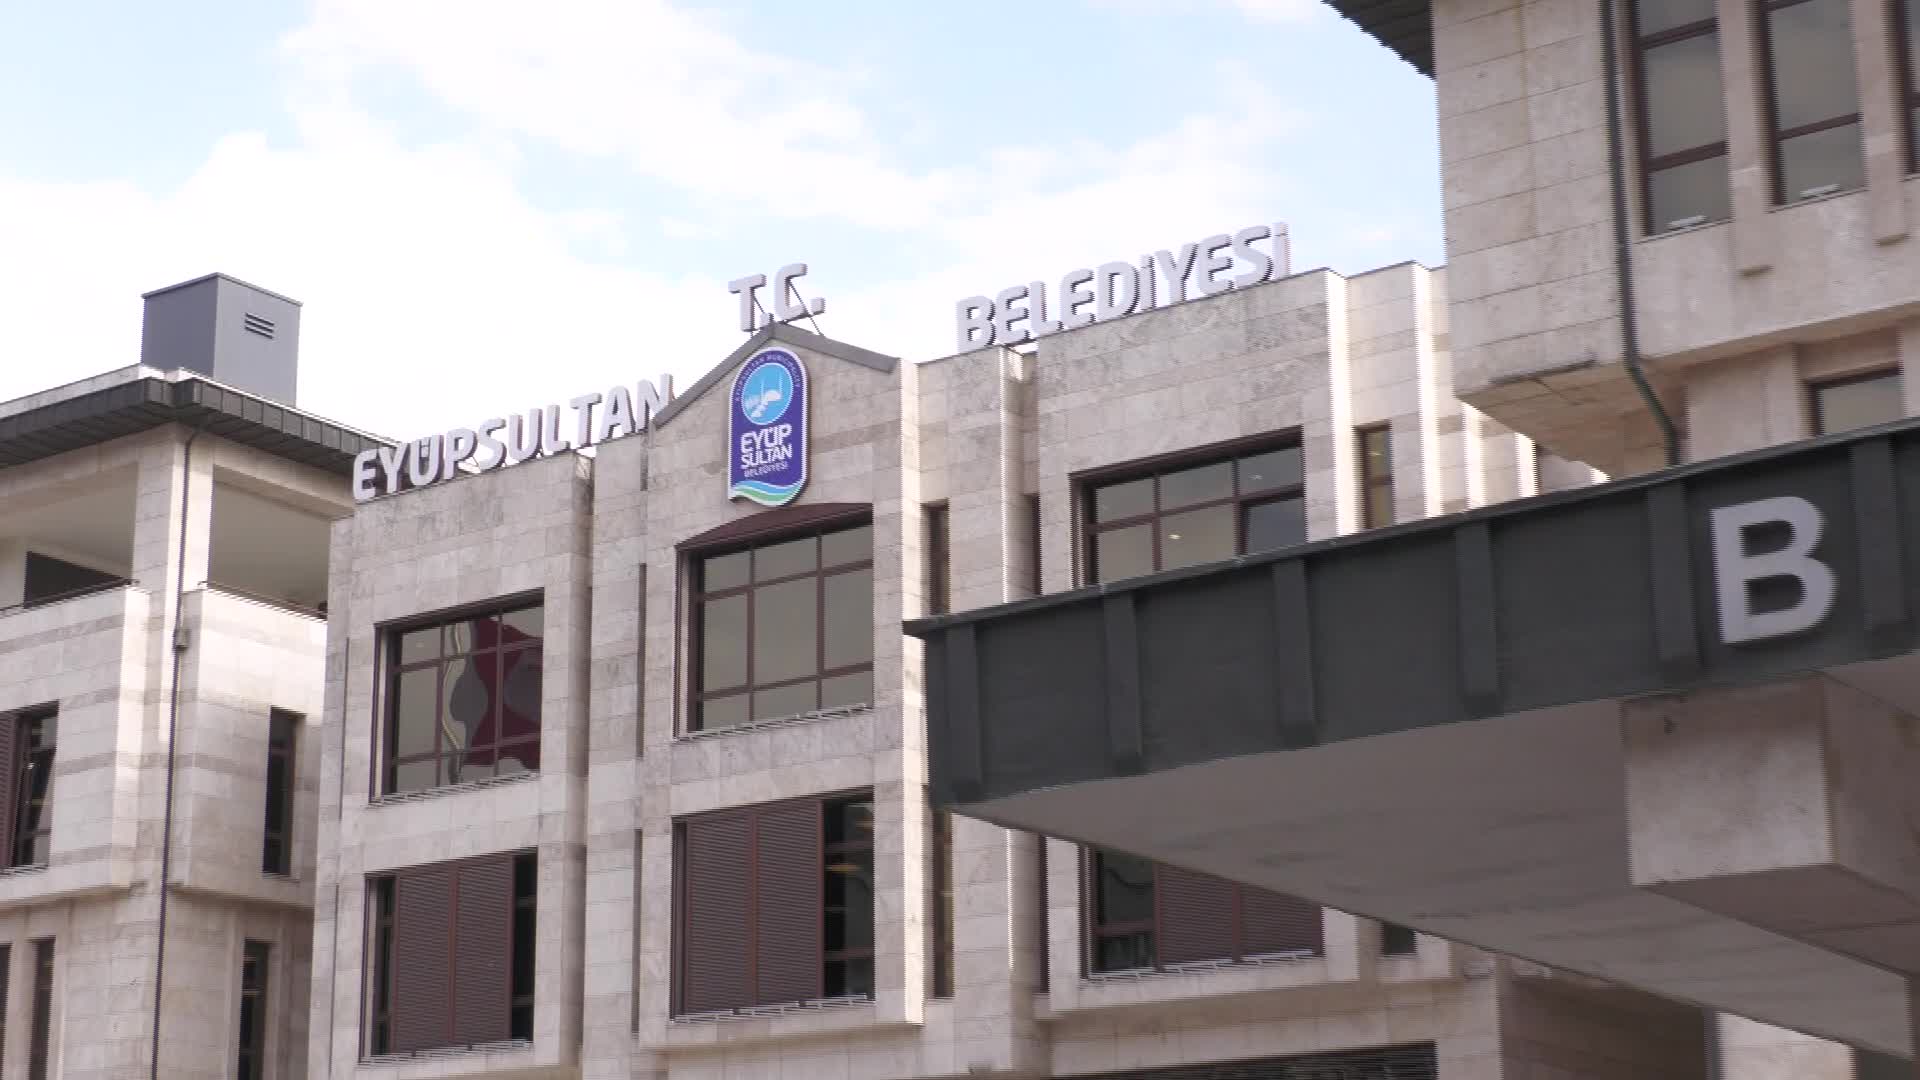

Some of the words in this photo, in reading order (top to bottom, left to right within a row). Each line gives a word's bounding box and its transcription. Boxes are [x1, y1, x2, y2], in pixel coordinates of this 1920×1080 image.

[727, 263, 826, 332] T.C.
[352, 373, 674, 501] EYÜPSULTAN
[740, 443, 793, 470] SULTAN
[741, 423, 793, 454] EYÜP
[1709, 496, 1839, 644] B
